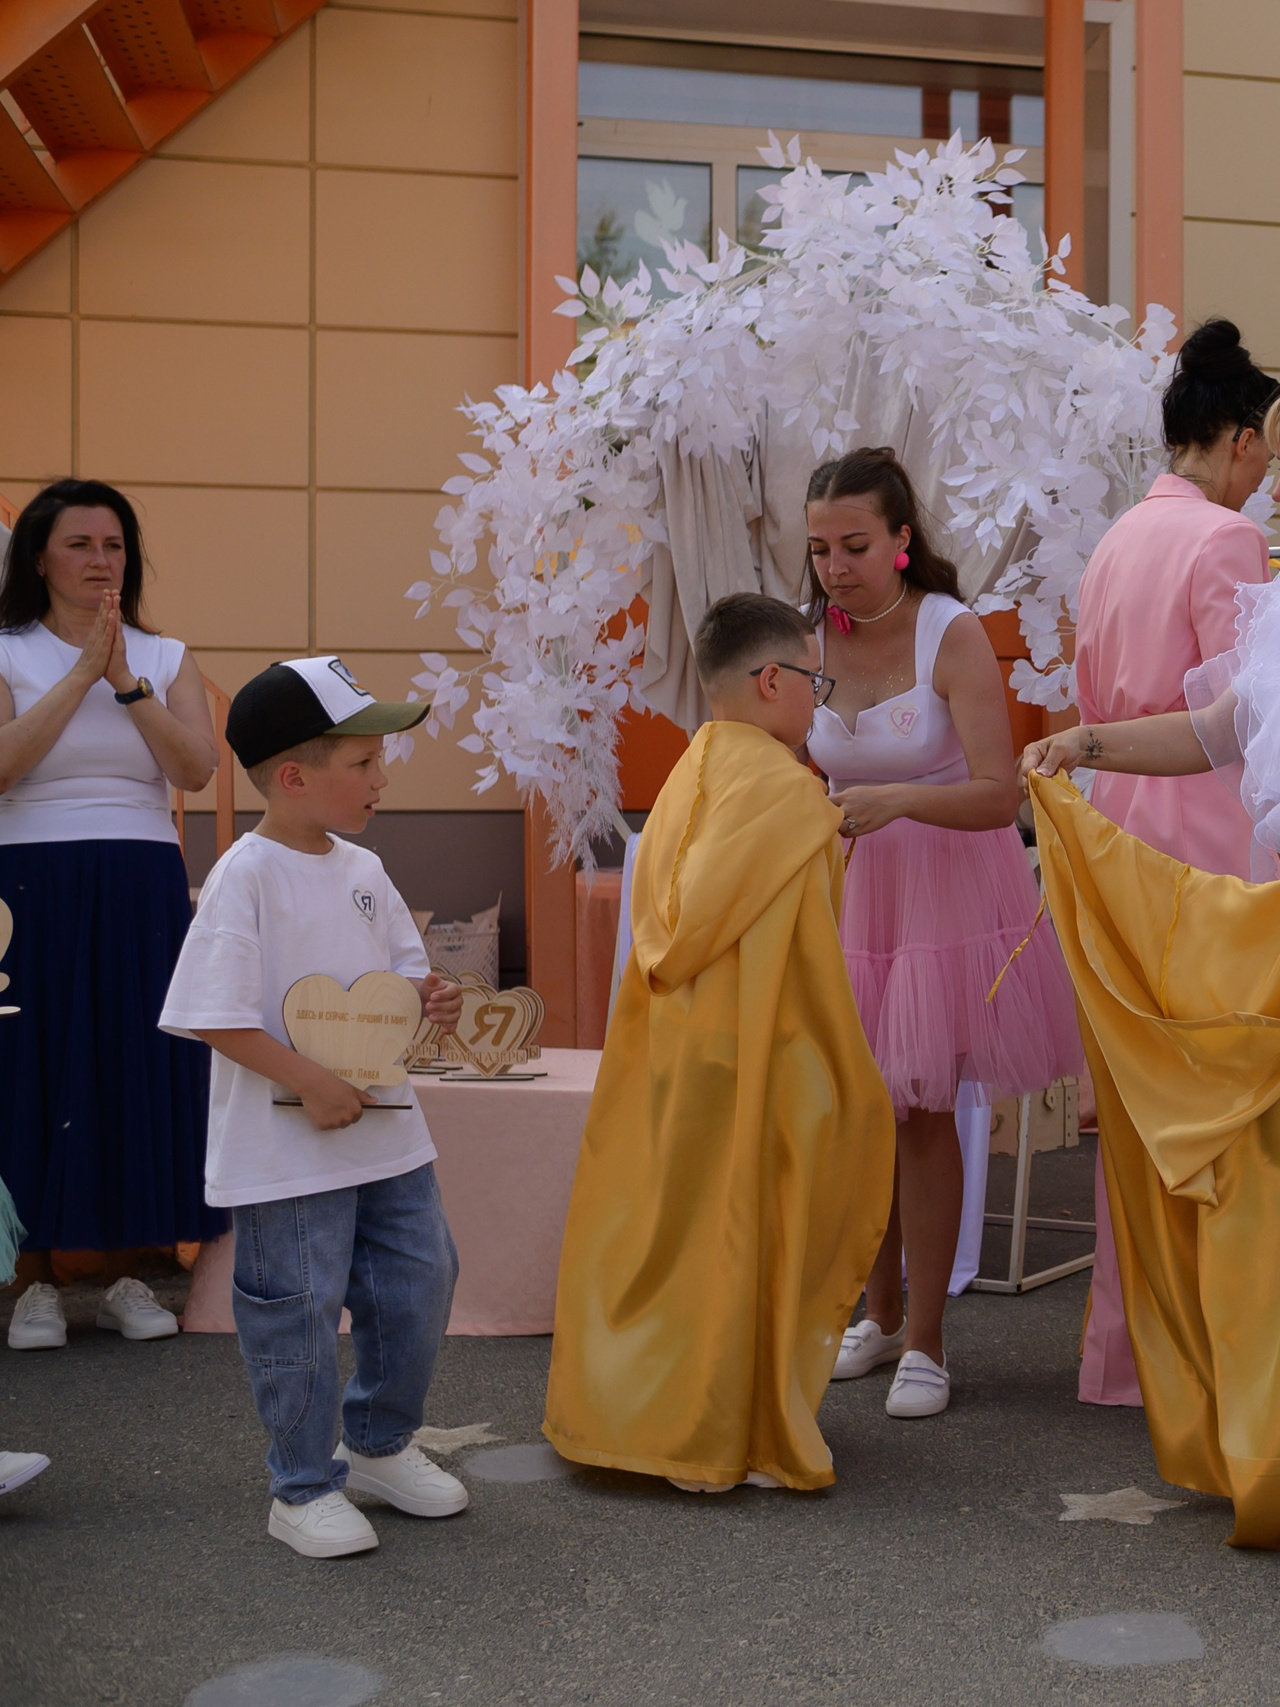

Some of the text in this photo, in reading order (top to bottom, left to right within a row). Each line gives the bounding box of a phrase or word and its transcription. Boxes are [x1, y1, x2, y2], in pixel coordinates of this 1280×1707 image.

[361, 895, 372, 911] Я
[296, 1009, 317, 1021] ЗДЕСЬ
[325, 1010, 350, 1022] СЕЙЧАС
[468, 1003, 516, 1047] Я
[328, 1068, 354, 1079] МЕНКО
